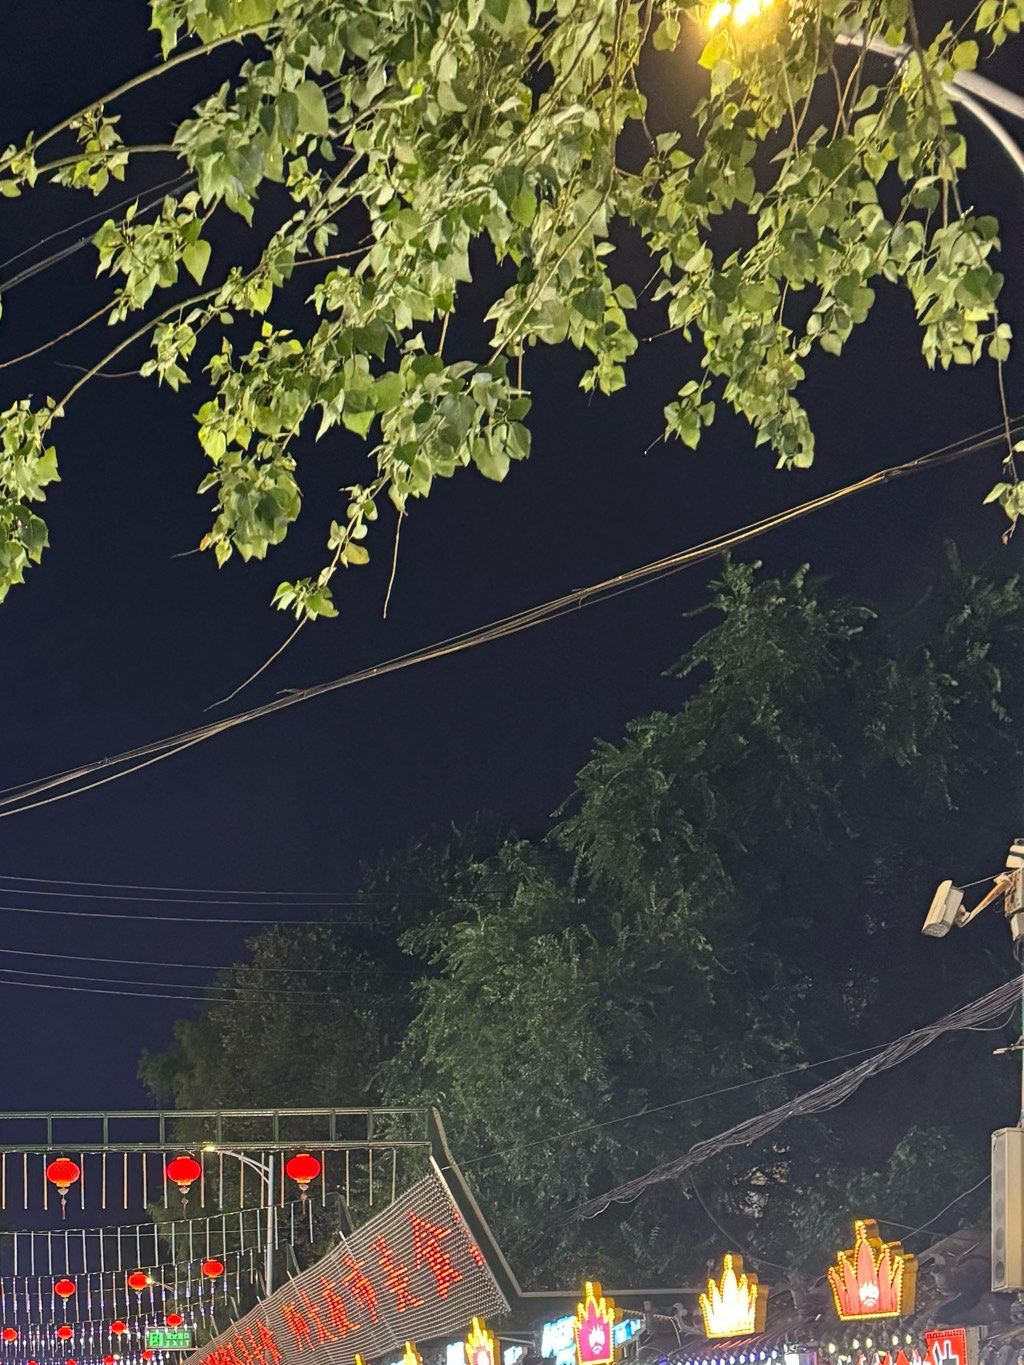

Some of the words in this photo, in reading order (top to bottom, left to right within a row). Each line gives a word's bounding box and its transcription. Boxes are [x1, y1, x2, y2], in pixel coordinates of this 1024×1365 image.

[282, 1208, 483, 1351] 师大夜市美食
